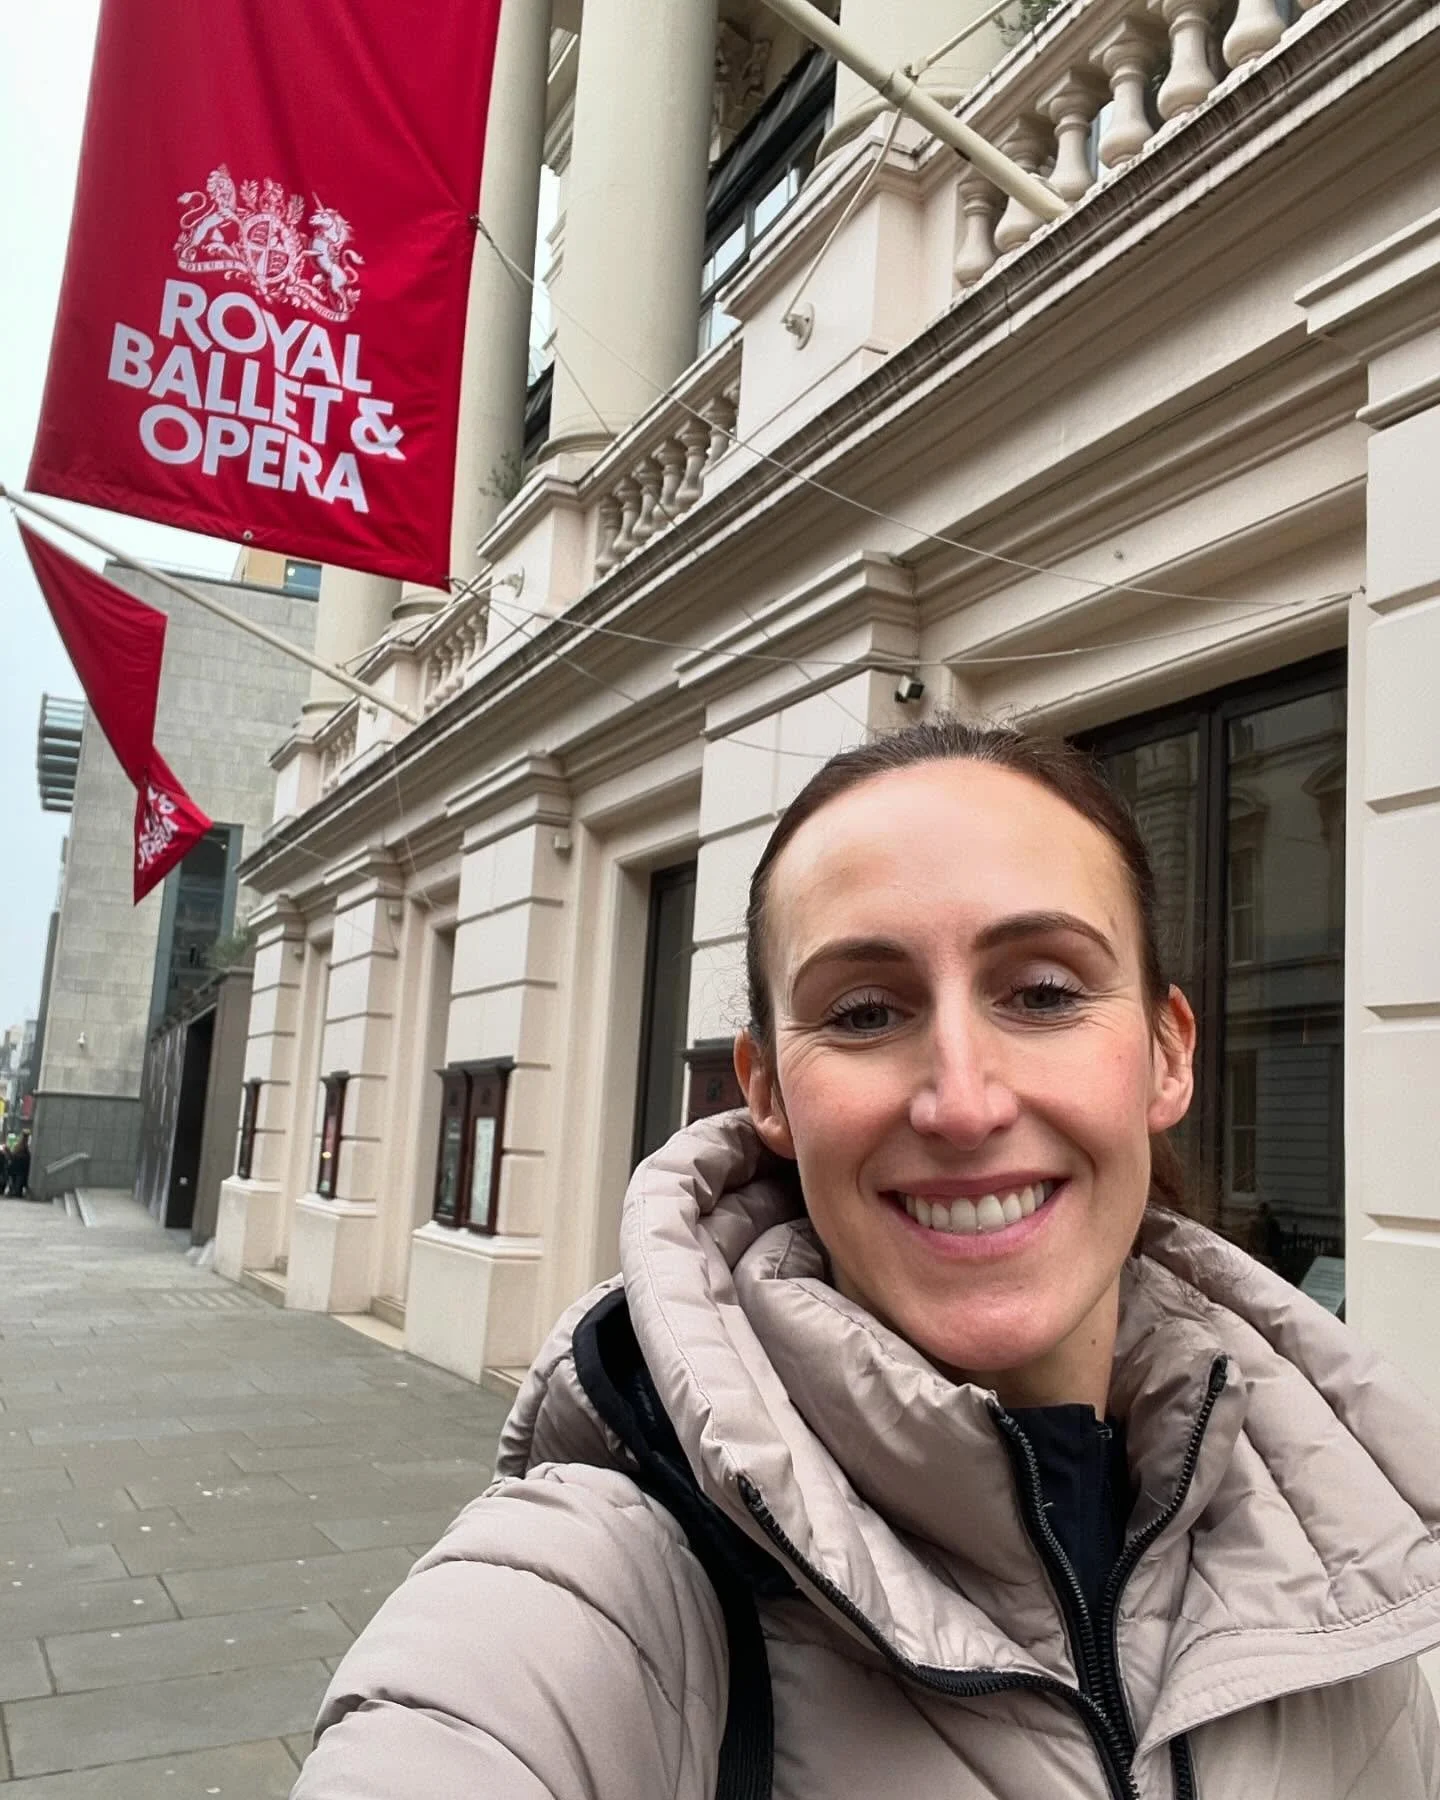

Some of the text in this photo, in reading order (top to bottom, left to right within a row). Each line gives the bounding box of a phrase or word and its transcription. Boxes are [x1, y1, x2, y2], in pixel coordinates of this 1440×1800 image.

[108, 322, 406, 461] BALLET &
[159, 279, 371, 394] ROYAL
[139, 405, 370, 514] OPERA
